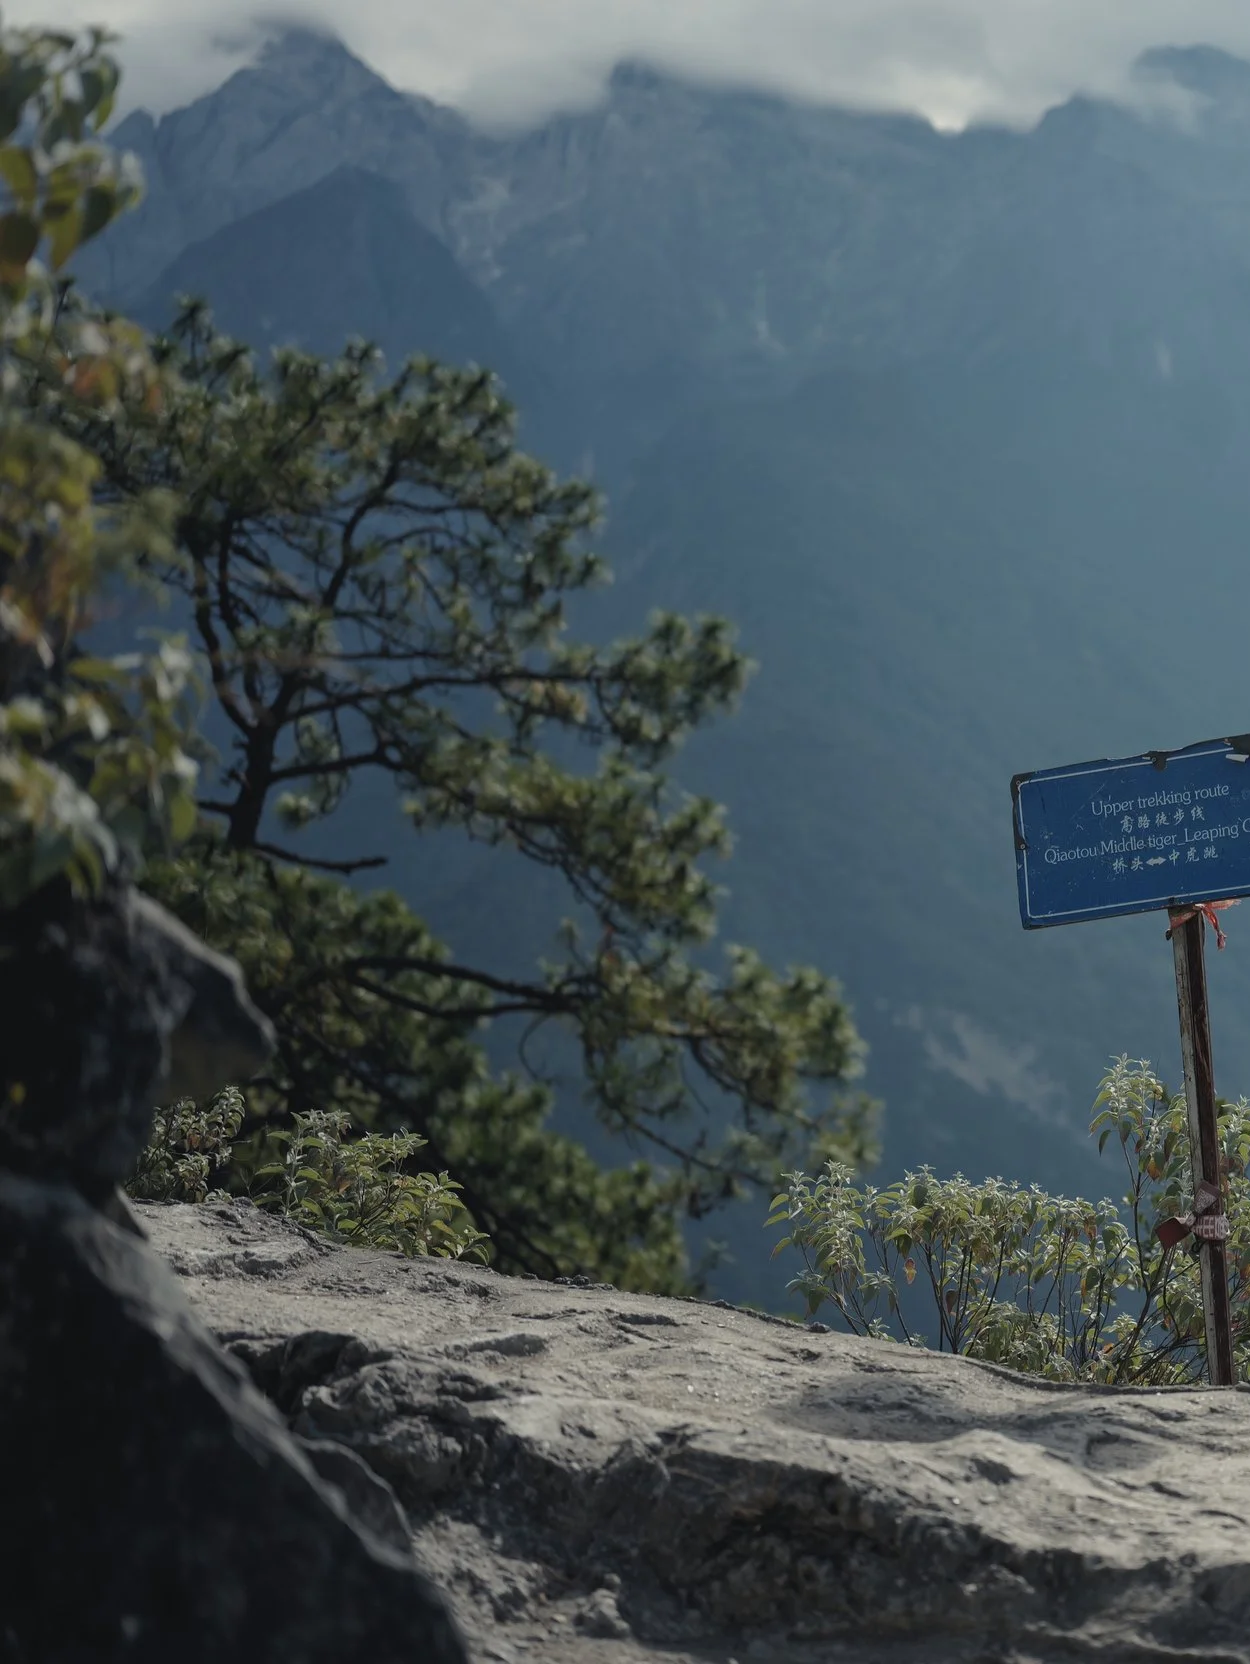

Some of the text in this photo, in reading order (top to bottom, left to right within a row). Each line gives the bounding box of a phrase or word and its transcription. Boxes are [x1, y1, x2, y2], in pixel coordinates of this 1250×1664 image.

[1091, 784, 1230, 818] Upper trekking route
[1044, 846, 1098, 864] Qiaotou
[1100, 836, 1145, 855] Middle
